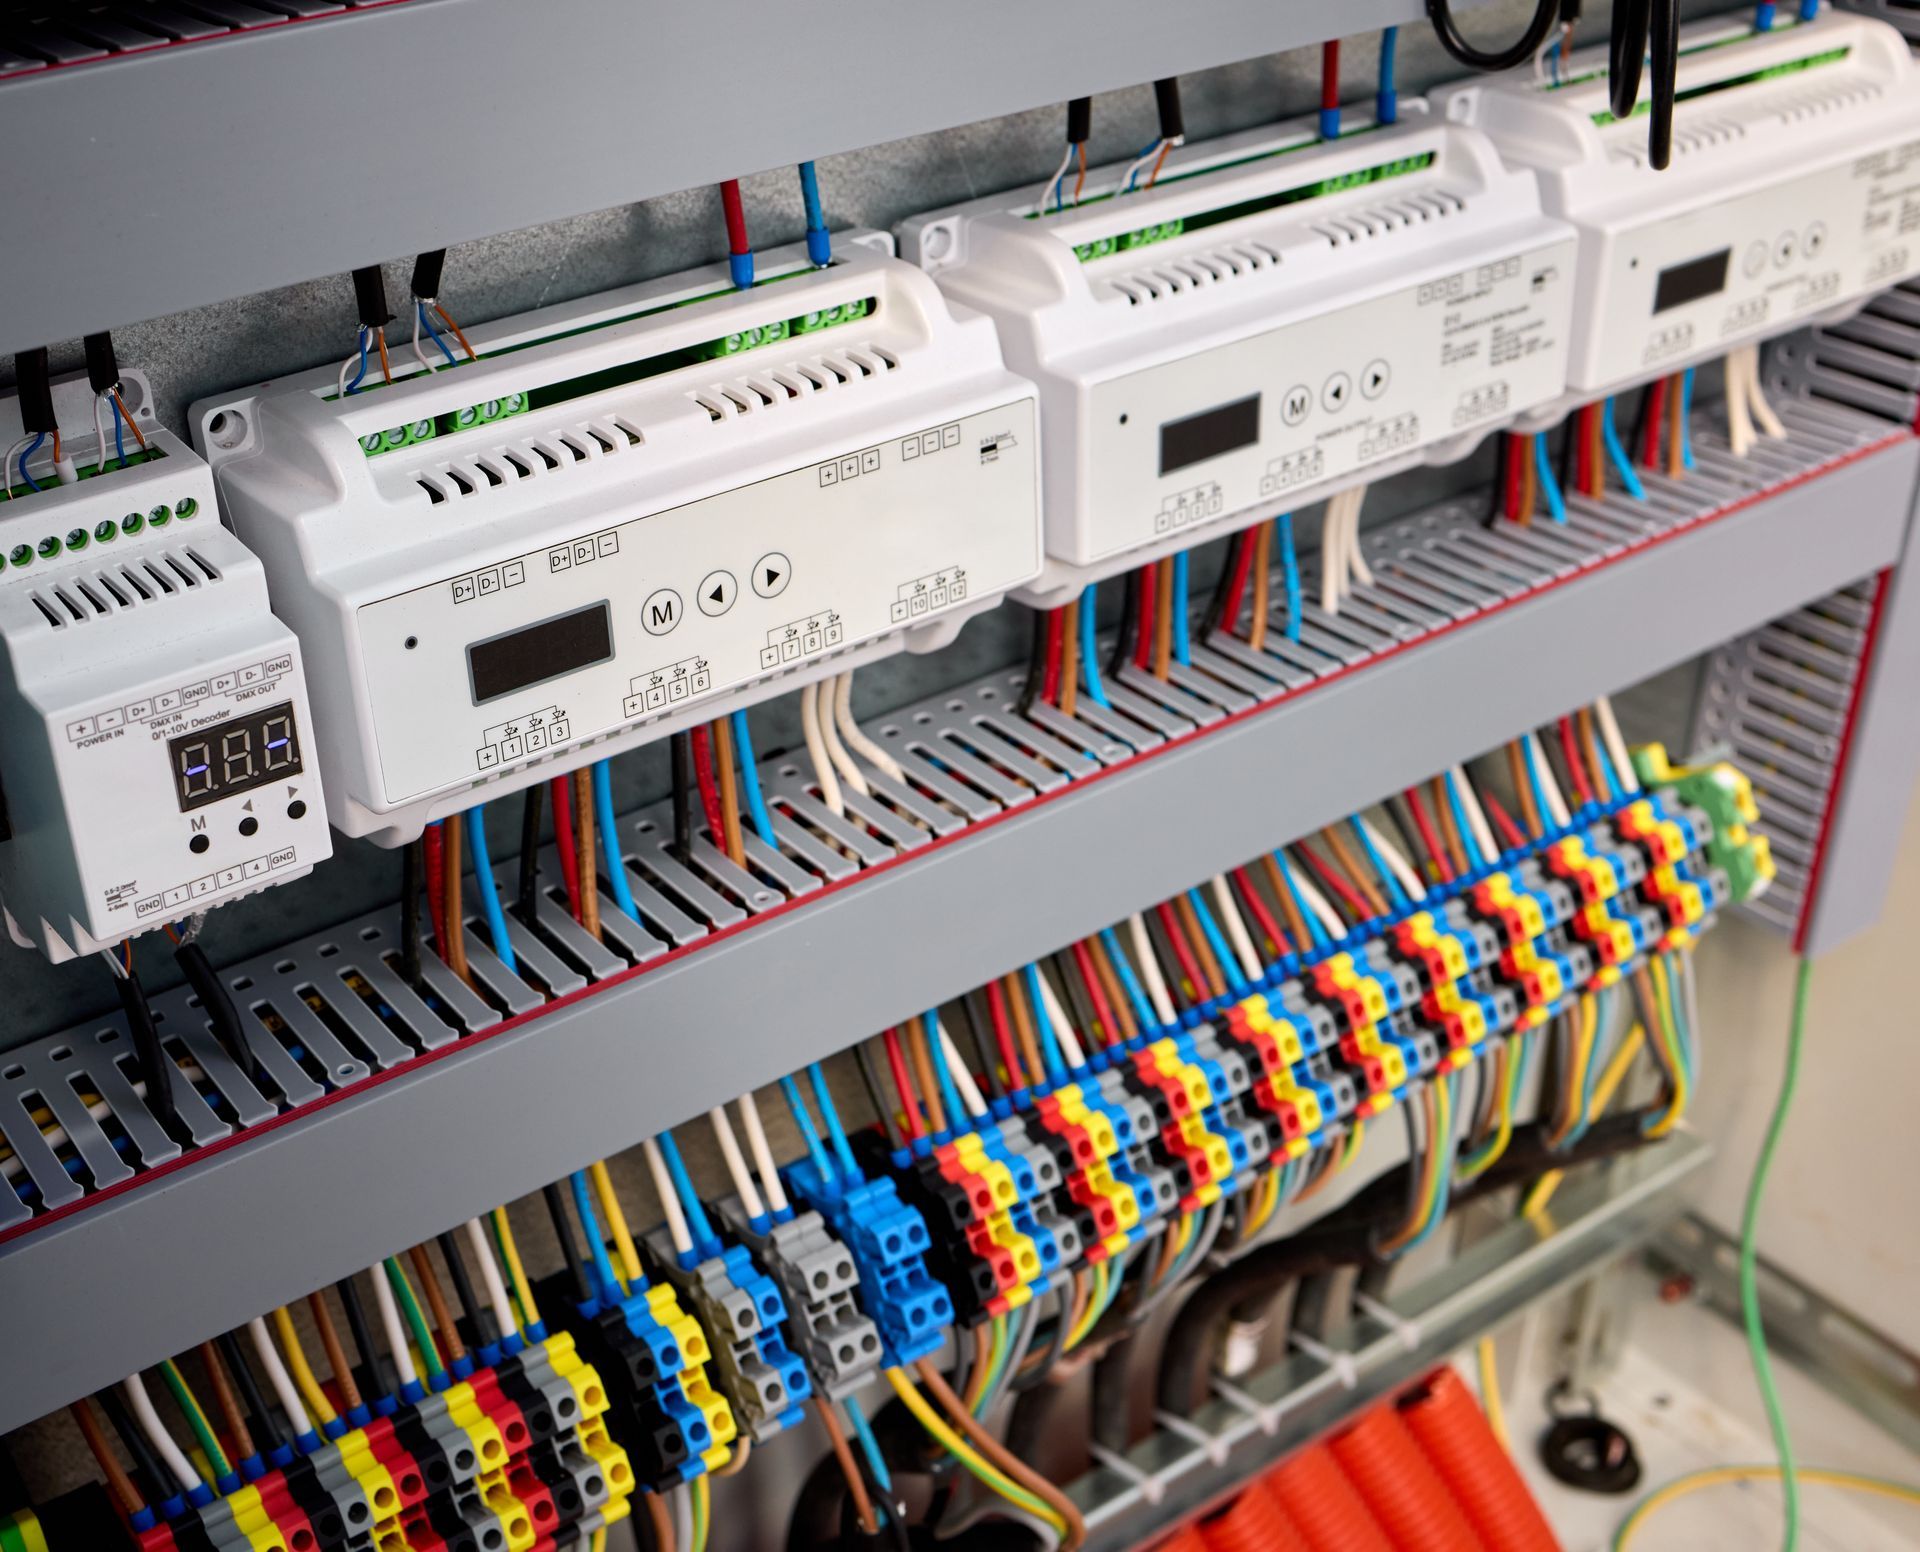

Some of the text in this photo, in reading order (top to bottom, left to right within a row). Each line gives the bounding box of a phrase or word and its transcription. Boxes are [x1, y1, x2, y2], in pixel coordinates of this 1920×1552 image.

[1289, 396, 1306, 417] M
[552, 555, 568, 567] D+
[577, 547, 591, 559] D-
[454, 585, 471, 598] D+
[481, 578, 496, 590] D-
[913, 599, 926, 610] 10
[934, 593, 945, 603] 11
[952, 586, 963, 596] 12
[651, 600, 673, 627] M
[788, 645, 794, 655] 7
[809, 637, 816, 648] 8
[830, 630, 837, 640] 9
[132, 707, 146, 716] D+
[161, 698, 174, 707] D-
[184, 686, 207, 699] GND
[217, 680, 230, 689] D+
[245, 671, 257, 680] D-
[267, 660, 290, 672] GND
[236, 682, 276, 702] DMX OUT
[653, 692, 660, 703] 4
[675, 685, 682, 695] 5
[697, 677, 704, 687] 6
[150, 713, 182, 730] DMX IN
[151, 709, 231, 741] 0/1-10V Decoder
[77, 729, 124, 750] POWER IN
[509, 743, 515, 753] 1
[532, 735, 540, 746] 2
[556, 726, 564, 737] 3
[190, 815, 207, 832] M
[137, 851, 294, 913] GND 1 2 3 4 GND
